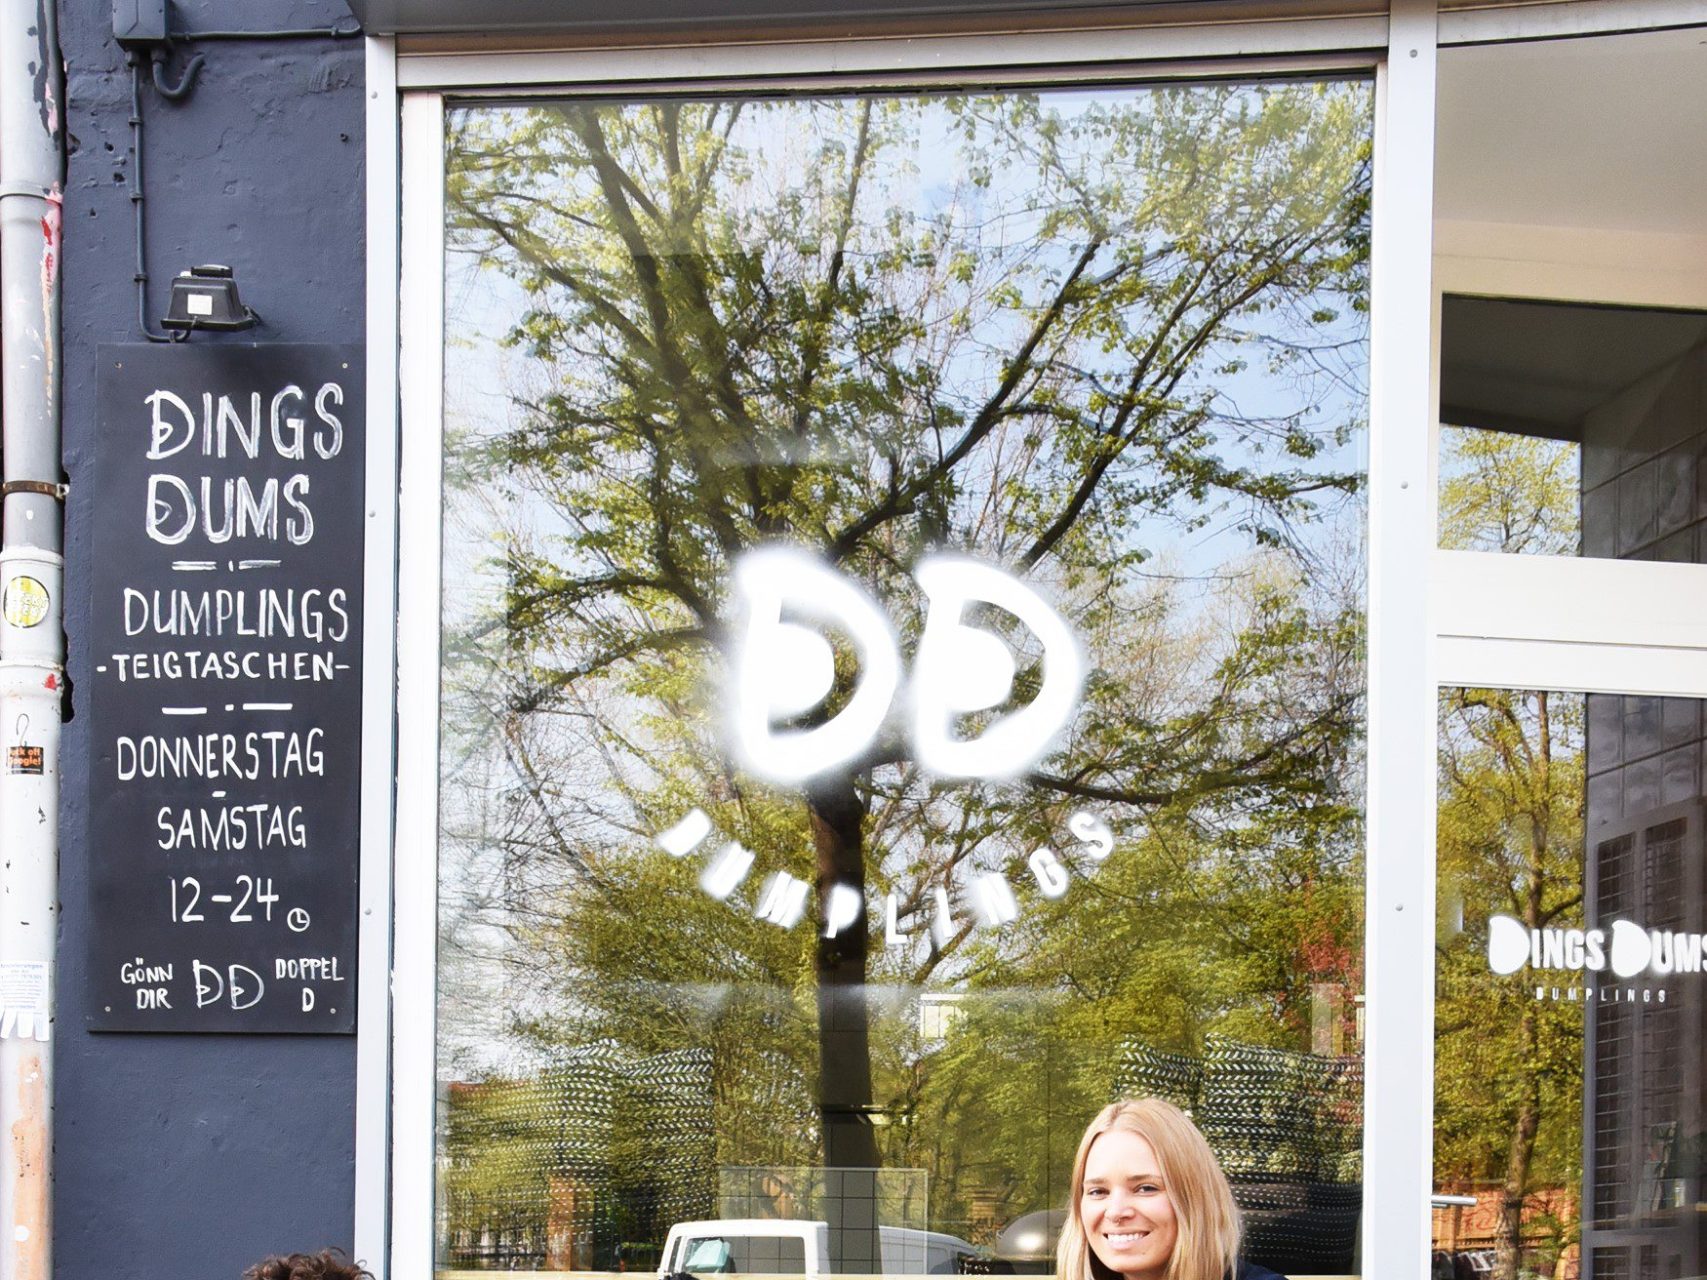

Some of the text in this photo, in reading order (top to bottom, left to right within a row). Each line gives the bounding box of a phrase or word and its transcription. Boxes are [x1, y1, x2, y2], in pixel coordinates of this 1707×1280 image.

[143, 382, 344, 461] DINGS
[145, 473, 315, 546] DUMS
[123, 586, 349, 644] DUMPLINGS
[737, 545, 1083, 782] DD
[116, 727, 324, 781] DONNERSTAG
[157, 803, 307, 852] SAMSTAG
[171, 874, 280, 923] 12-24
[120, 956, 174, 985] GÖNN
[275, 956, 345, 982] DOPPEL
[1610, 919, 1707, 978] DUM
[136, 987, 173, 1010] DIR
[301, 987, 315, 1013] D
